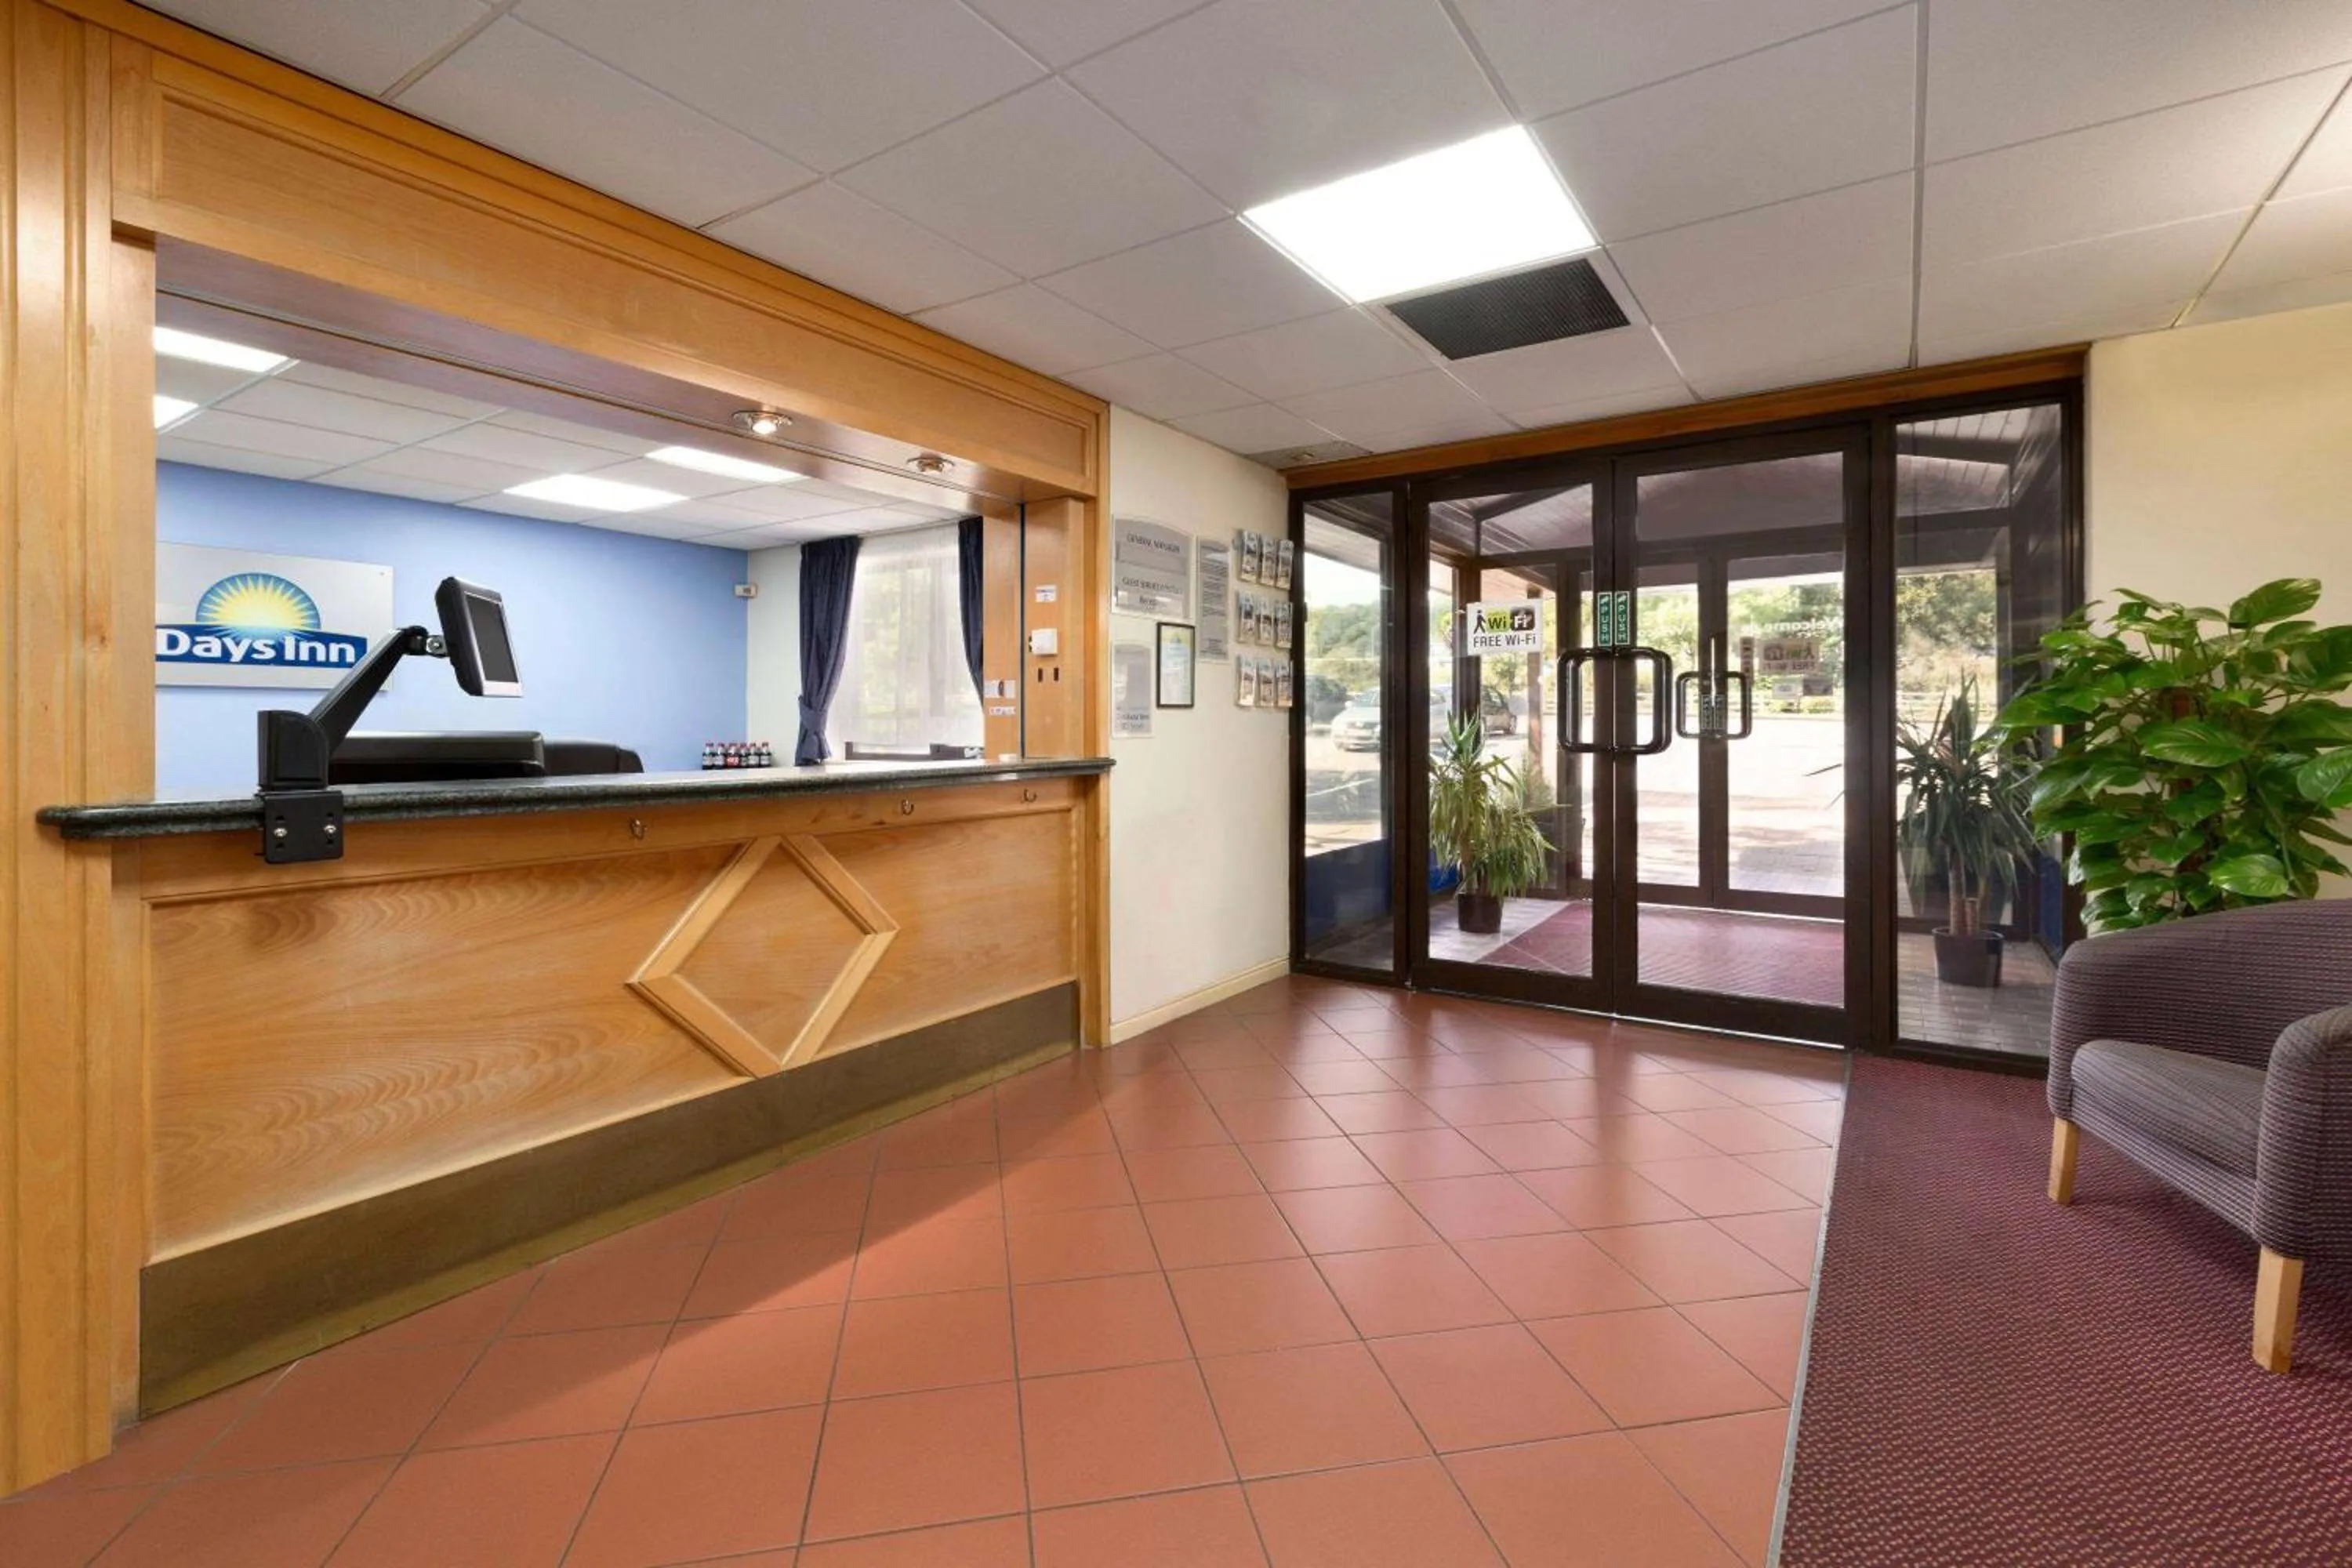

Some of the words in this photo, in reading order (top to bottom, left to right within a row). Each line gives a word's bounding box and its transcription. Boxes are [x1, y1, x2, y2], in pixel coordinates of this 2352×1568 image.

[1617, 604, 1627, 641] PUSH
[155, 628, 276, 662] Days
[284, 636, 355, 663] Inn
[1473, 634, 1502, 648] FREE
[1504, 633, 1537, 646] Wi-Fi
